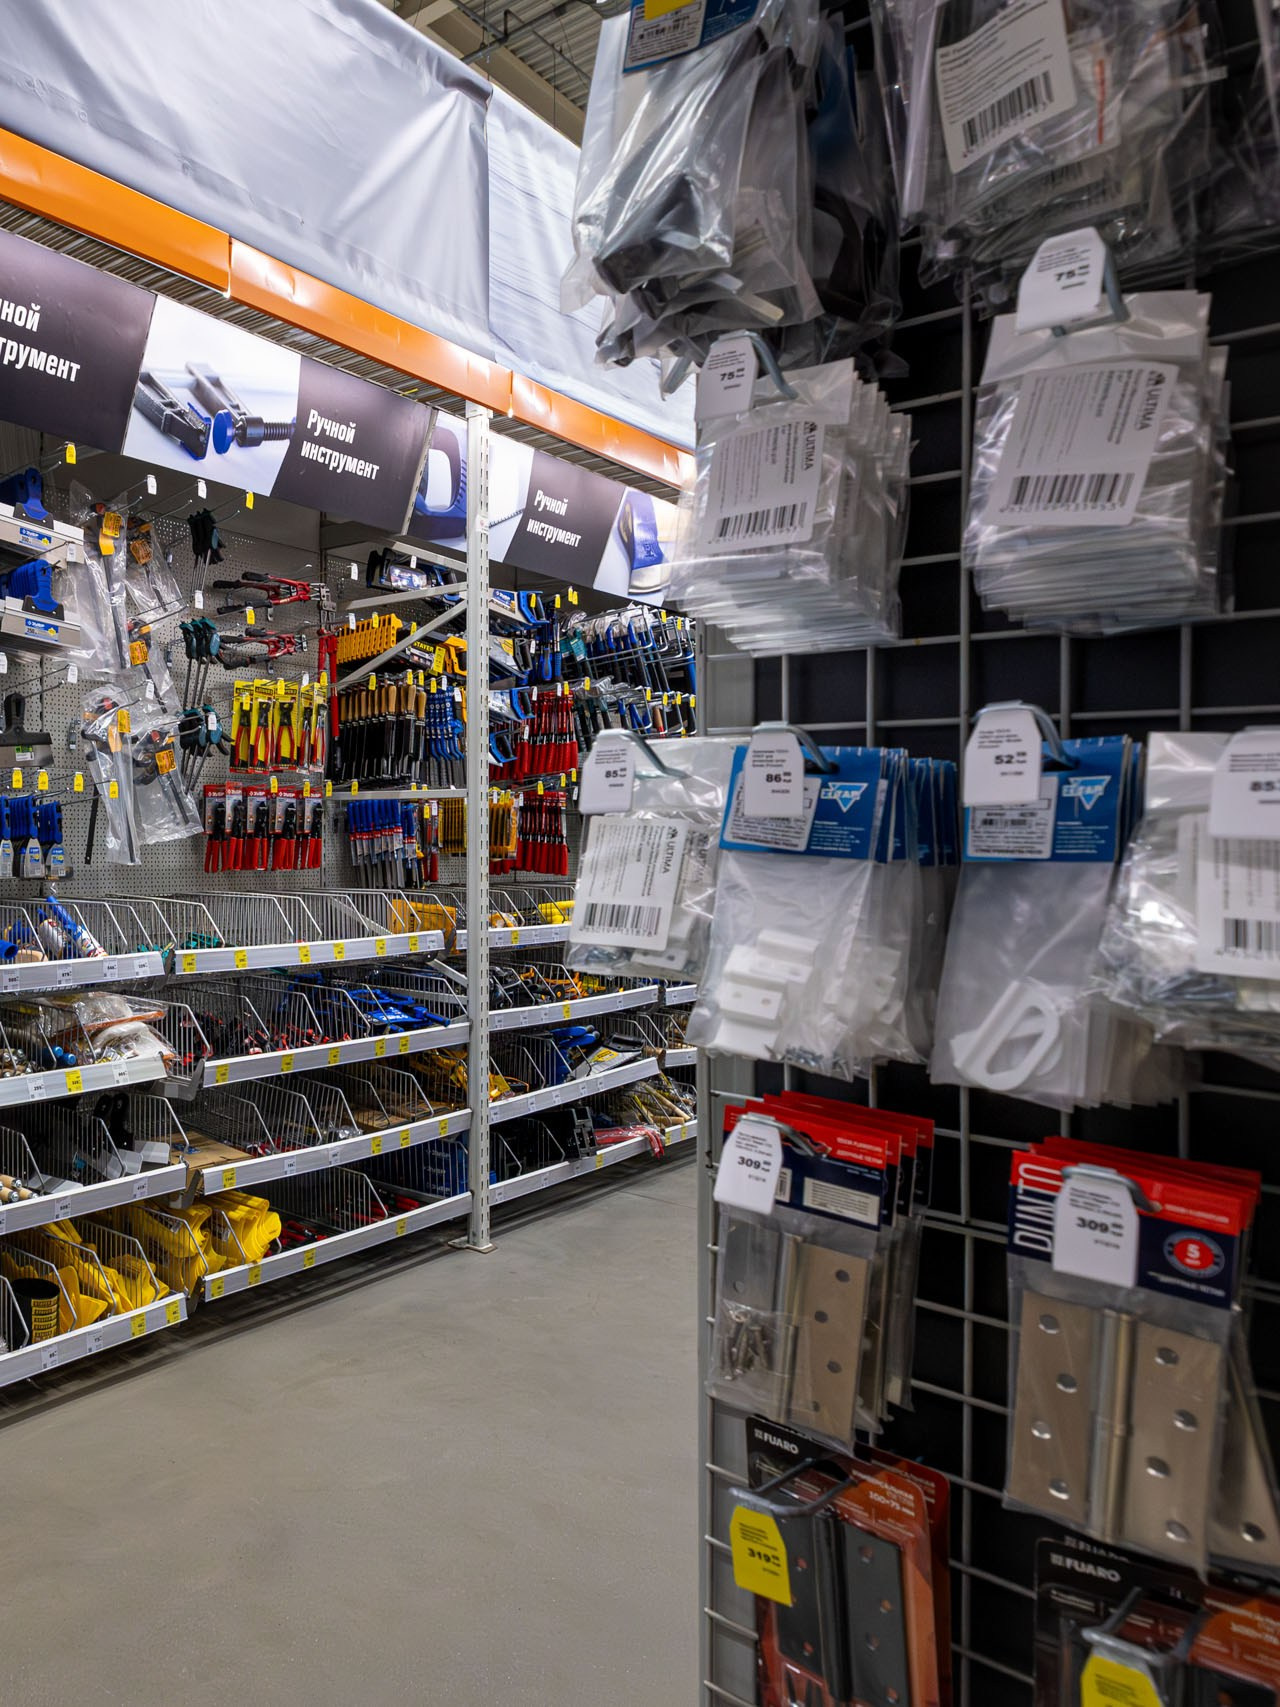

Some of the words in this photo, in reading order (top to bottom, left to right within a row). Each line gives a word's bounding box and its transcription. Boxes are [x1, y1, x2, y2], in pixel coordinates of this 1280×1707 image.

[720, 371, 735, 381] 75
[1137, 387, 1162, 431] ULTIMA
[306, 408, 357, 444] Ручной
[300, 439, 380, 481] инструмент
[804, 434, 816, 471] ULTIMA
[534, 489, 568, 517] Ручной
[526, 517, 581, 549] инструмент
[413, 641, 434, 653] STAYER
[994, 755, 1014, 765] 52
[605, 770, 619, 779] 85
[765, 773, 782, 783] 86
[662, 841, 676, 874] ULTIMA
[737, 1156, 761, 1170] 309
[1075, 1216, 1110, 1234] 309
[762, 1434, 799, 1455] FUARO
[748, 1547, 772, 1563] 319
[1063, 1557, 1121, 1583] FUARO
